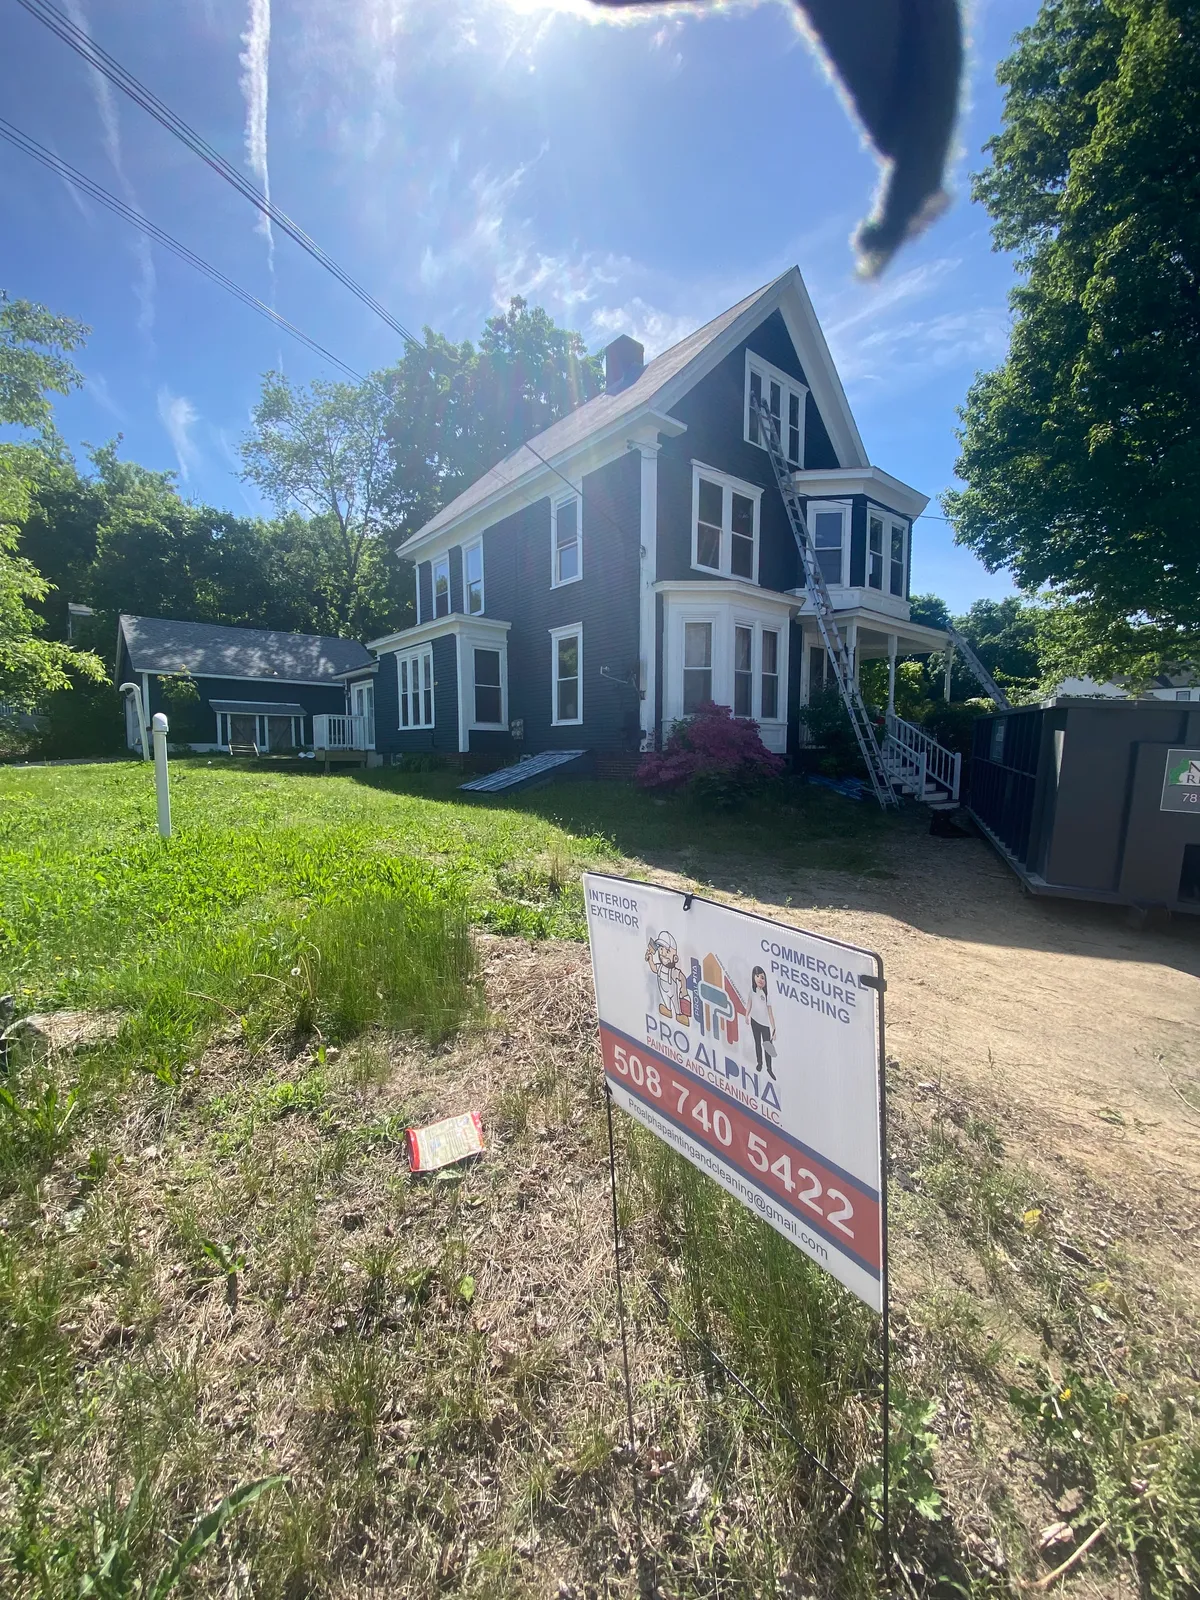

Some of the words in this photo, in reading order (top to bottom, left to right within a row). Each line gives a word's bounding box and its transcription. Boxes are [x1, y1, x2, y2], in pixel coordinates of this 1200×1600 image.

[1182, 792, 1200, 803] 78
[1186, 774, 1200, 784] R
[588, 888, 639, 913] INTERIOR
[590, 904, 640, 929] EXTERIOR
[770, 960, 857, 1008] PRESSURE
[776, 980, 851, 1025] WASHING
[645, 1013, 690, 1054] PRO
[646, 1035, 684, 1064] PAINTING
[685, 1058, 705, 1077] AND
[707, 1071, 758, 1110] CLEANING
[761, 1103, 783, 1128] LLC.
[614, 1044, 663, 1098] 508
[672, 1080, 733, 1147] 740
[747, 1131, 855, 1239] 5422
[628, 1097, 829, 1261] Proalphapaintingandcleaning@gmail.com
